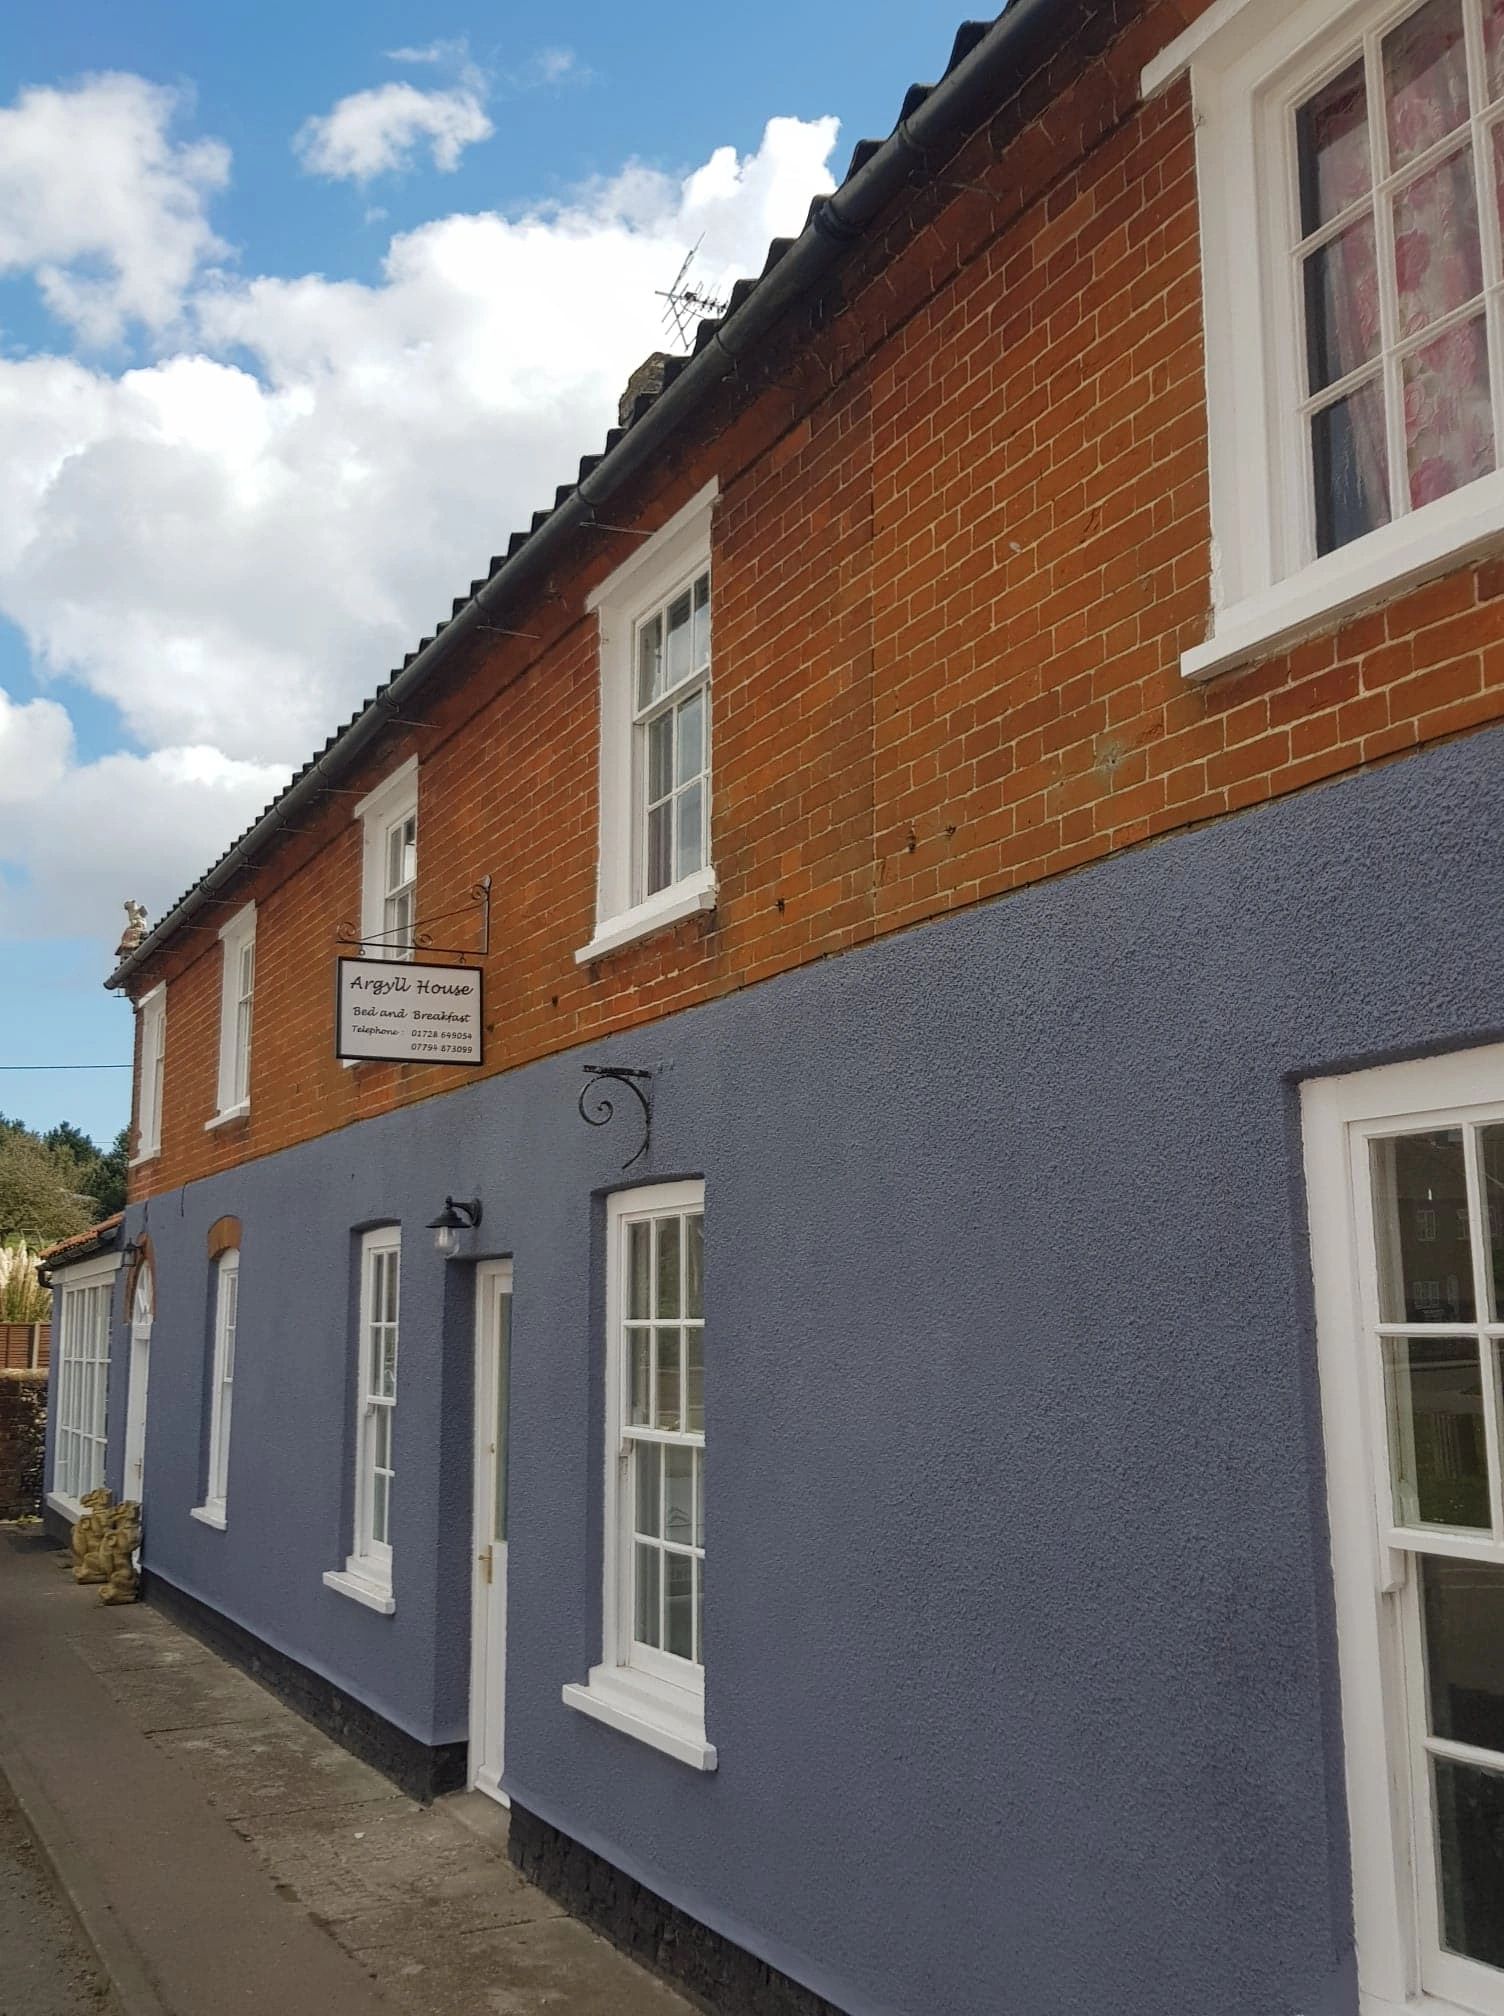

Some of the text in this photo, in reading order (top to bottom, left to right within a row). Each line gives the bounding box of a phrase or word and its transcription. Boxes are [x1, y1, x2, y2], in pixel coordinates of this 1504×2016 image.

[350, 976, 473, 996] Argyll House
[353, 1006, 471, 1023] Bed and Breakfast
